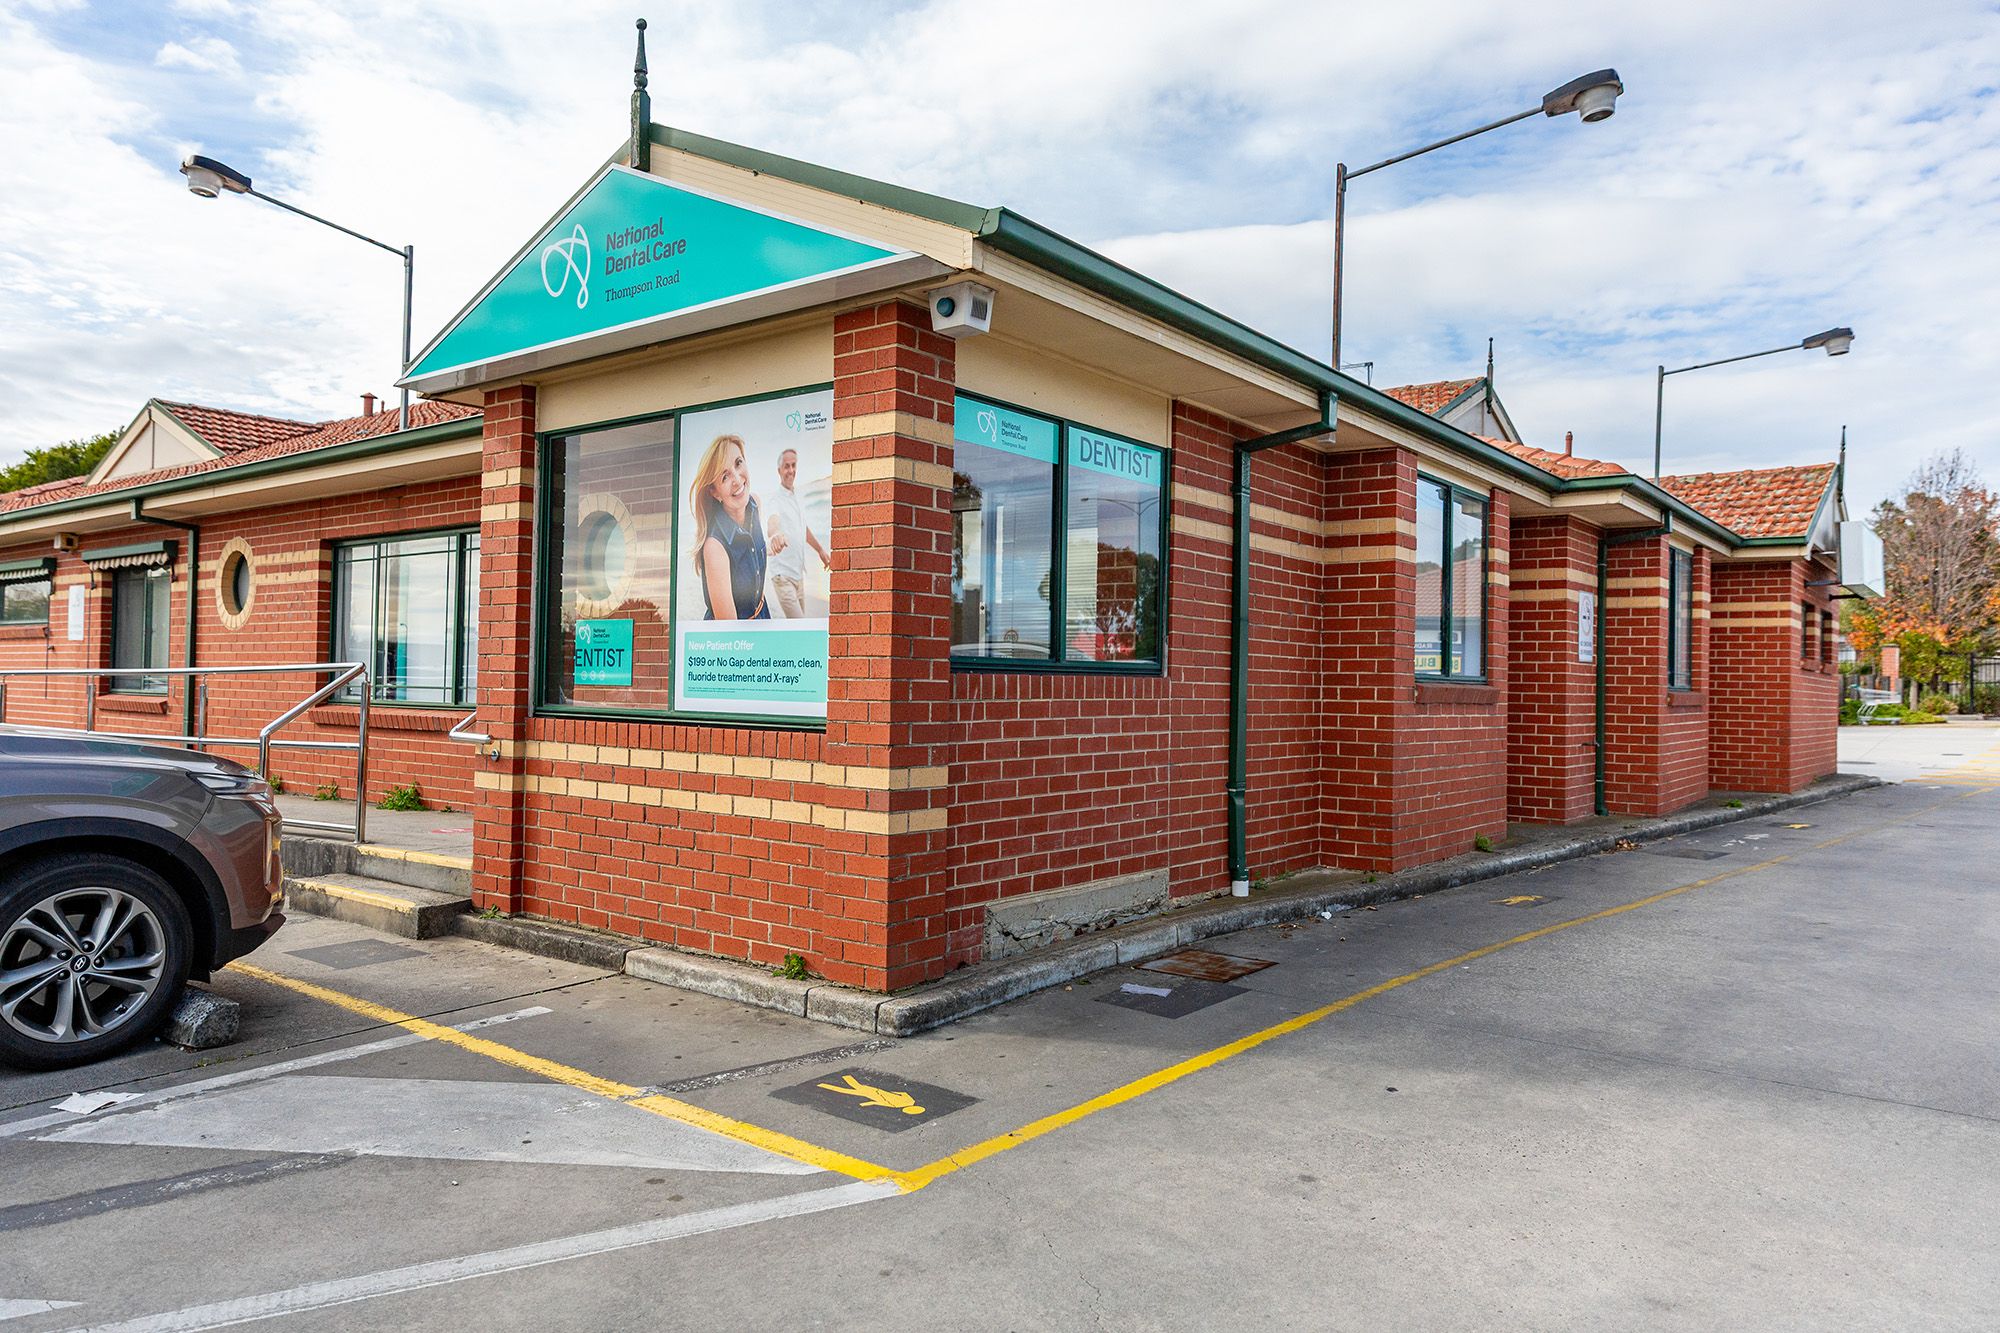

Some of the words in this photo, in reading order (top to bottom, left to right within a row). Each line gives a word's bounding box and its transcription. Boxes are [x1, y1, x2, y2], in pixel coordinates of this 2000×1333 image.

[606, 217, 664, 252] National
[605, 244, 651, 275] Dental
[653, 238, 686, 261] Care
[605, 282, 652, 302] Thompson
[655, 270, 680, 289] Road
[1001, 428, 1017, 439] Dental
[1017, 432, 1028, 442] Care
[1080, 436, 1152, 478] DENTIST
[688, 640, 705, 650] New
[706, 640, 732, 650] Patient
[734, 640, 754, 650] Offer
[688, 656, 706, 667] $199
[707, 658, 716, 667] or
[717, 657, 727, 667] No
[729, 657, 745, 669] Gap
[746, 657, 771, 667] dental
[773, 659, 796, 669] exam,
[798, 657, 823, 669] clean,
[688, 671, 716, 682] fluoride
[718, 672, 755, 682] treatment
[757, 672, 772, 683] and
